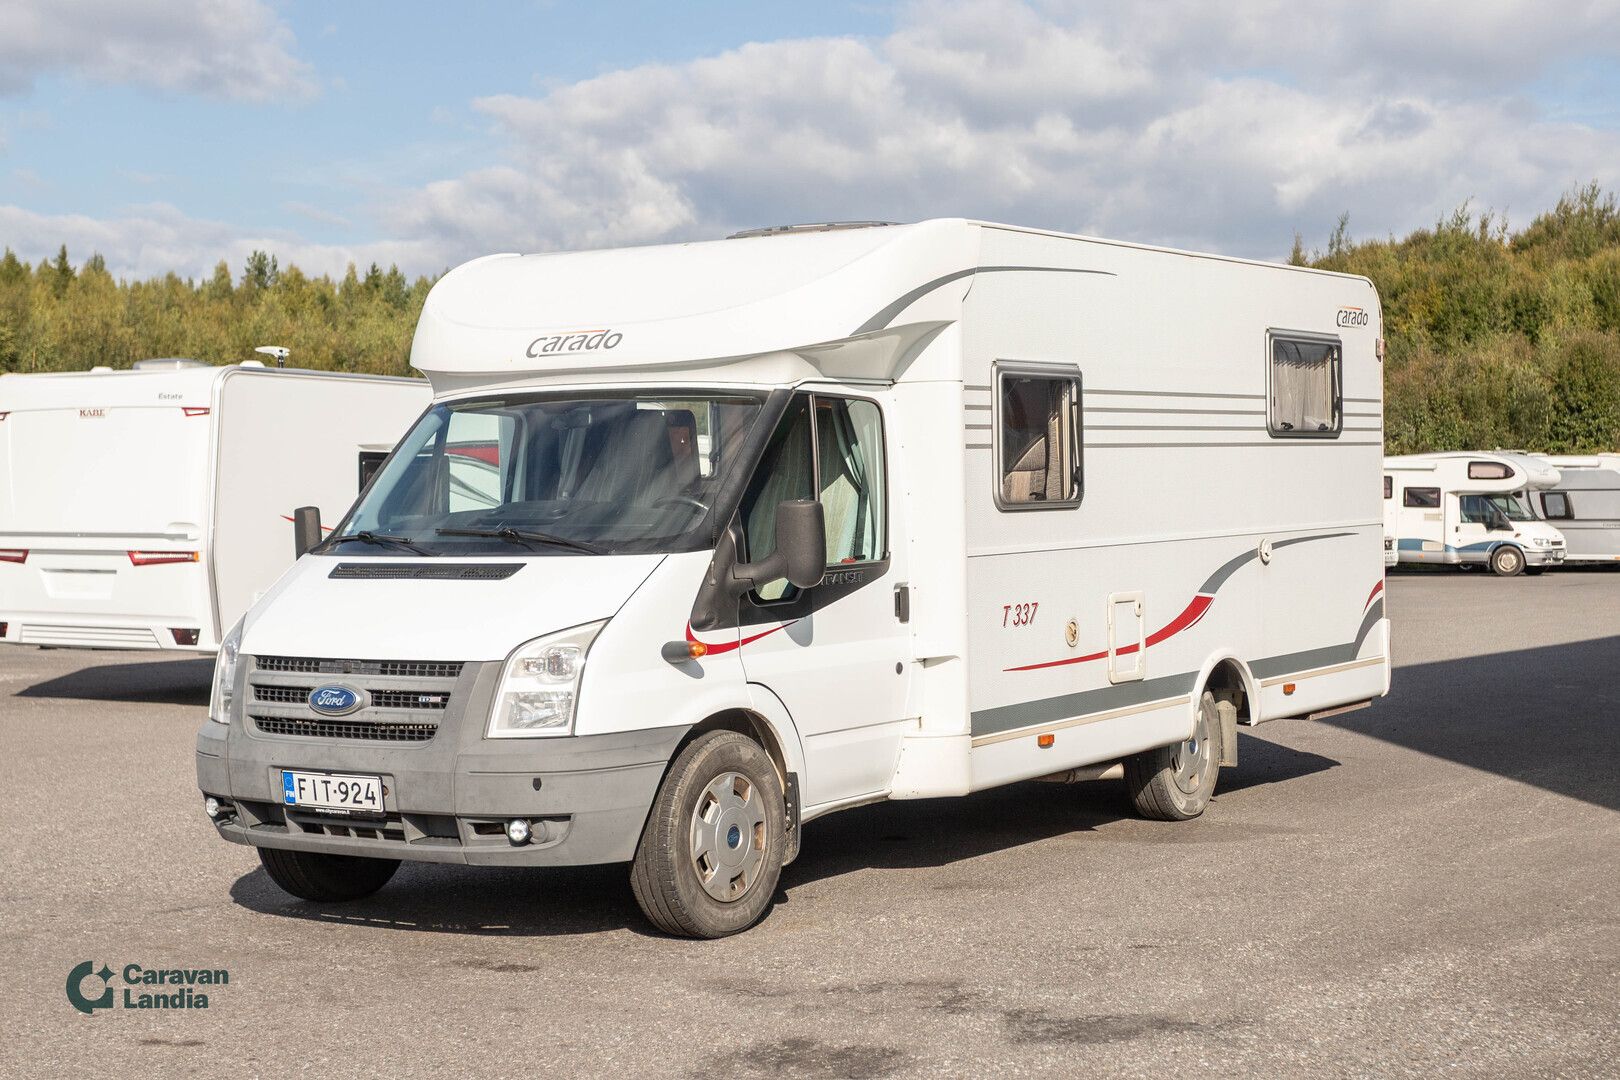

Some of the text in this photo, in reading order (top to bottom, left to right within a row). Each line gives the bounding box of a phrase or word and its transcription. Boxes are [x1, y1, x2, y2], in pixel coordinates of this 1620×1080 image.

[79, 408, 106, 417] KABE
[1003, 602, 1039, 628] T 337
[317, 689, 347, 706] Ford
